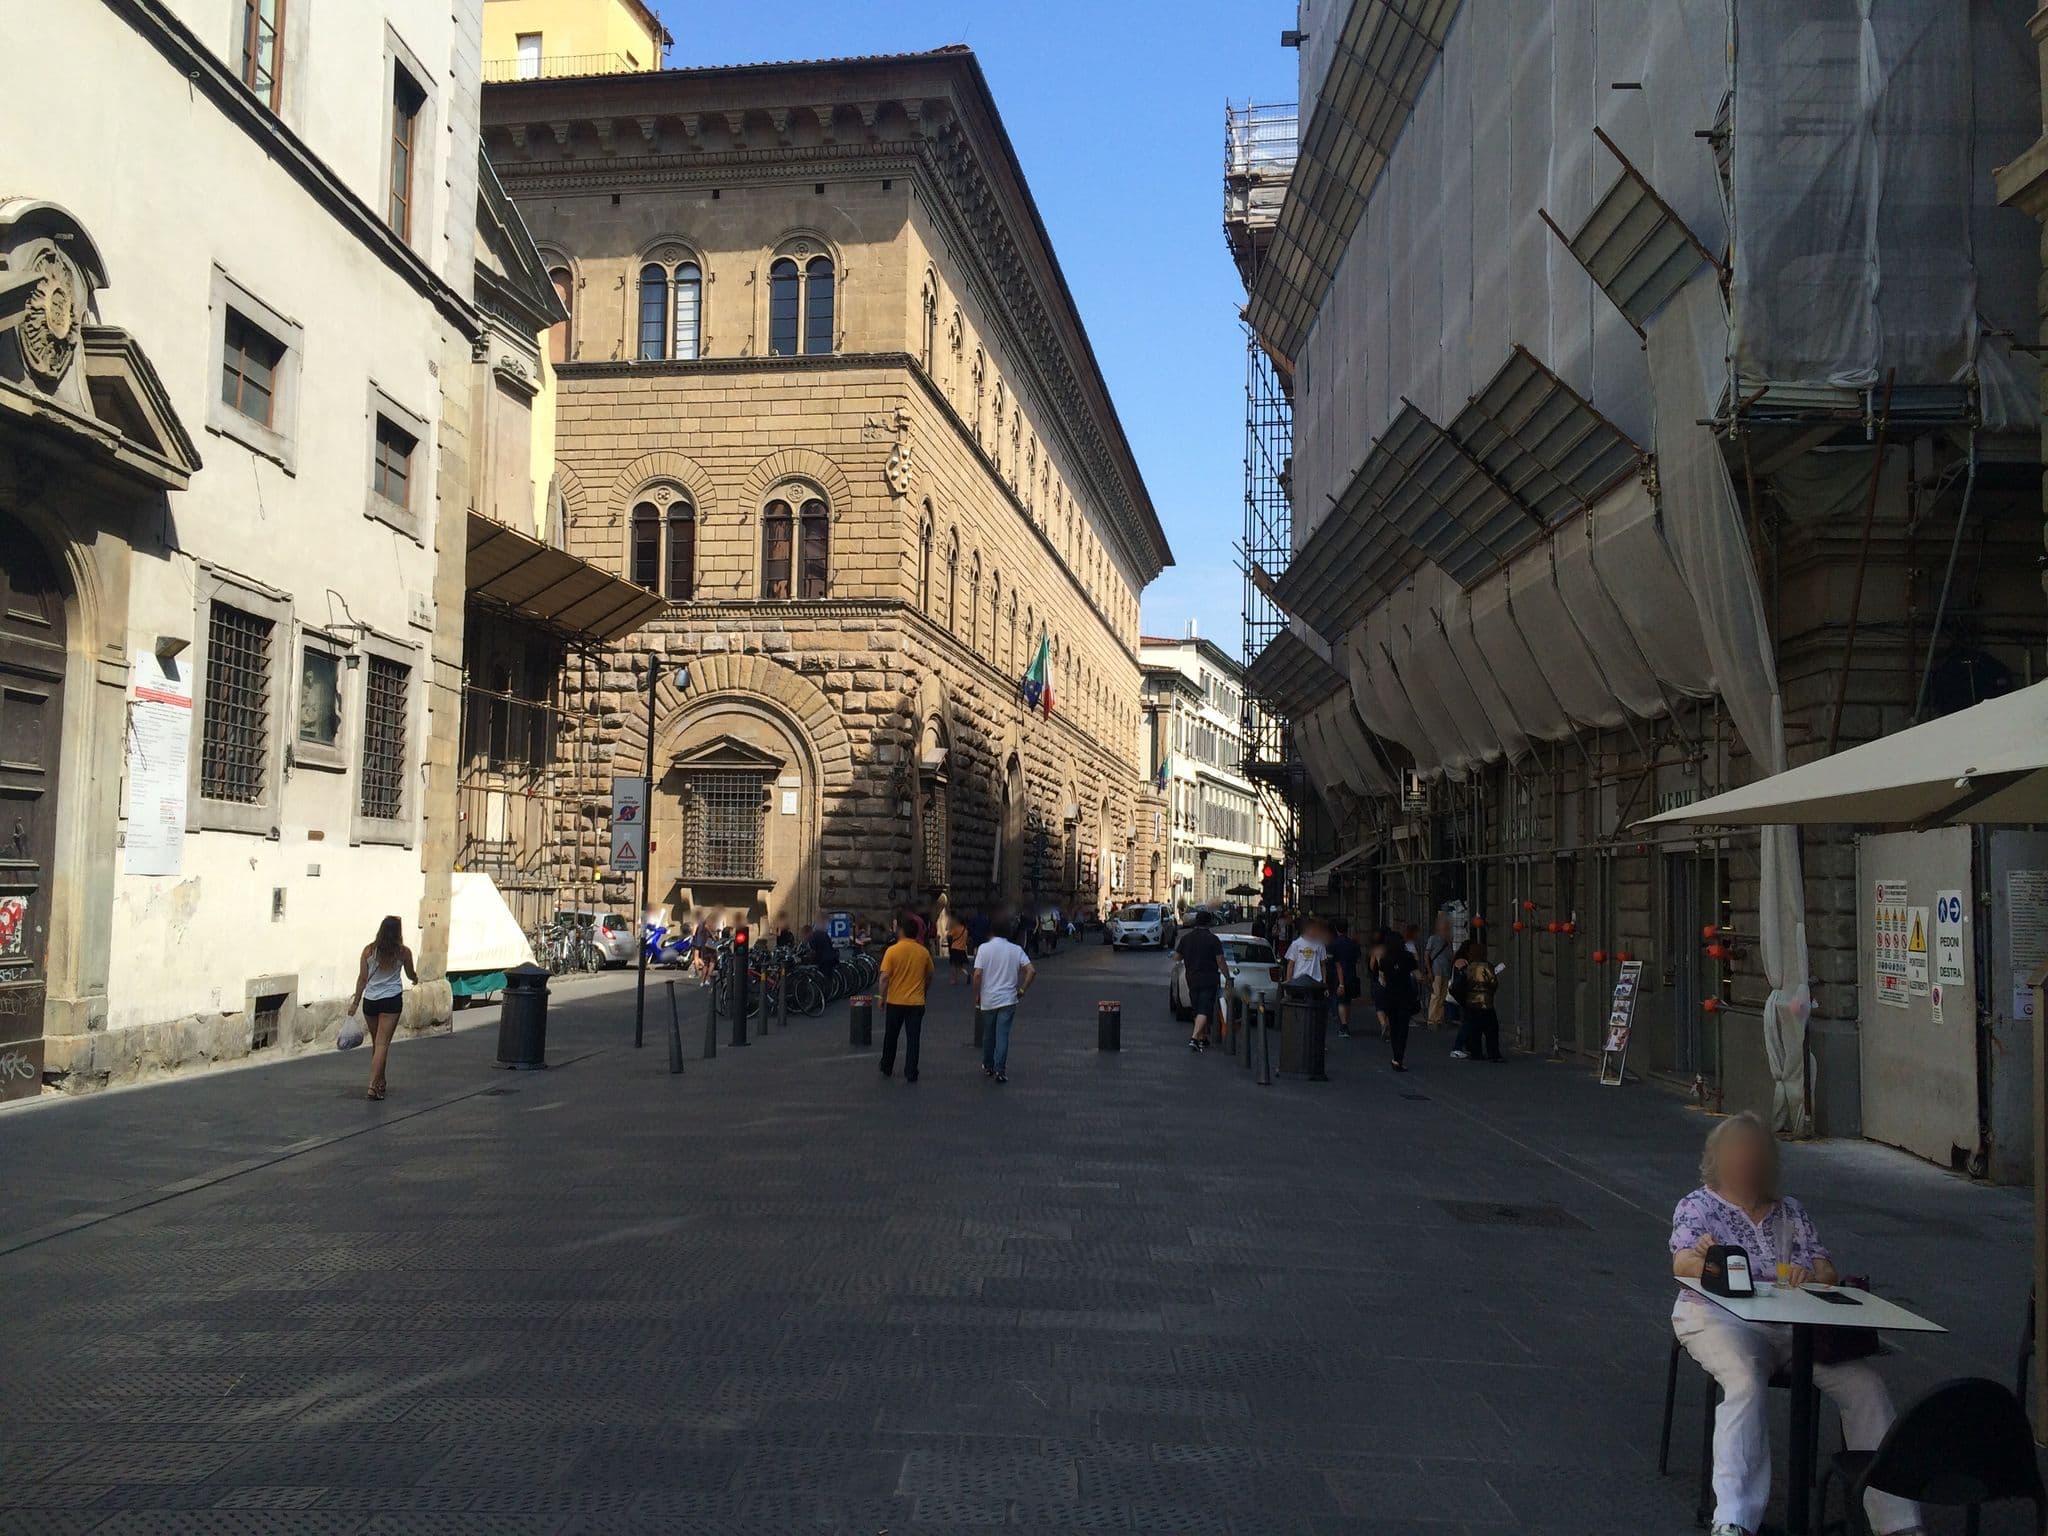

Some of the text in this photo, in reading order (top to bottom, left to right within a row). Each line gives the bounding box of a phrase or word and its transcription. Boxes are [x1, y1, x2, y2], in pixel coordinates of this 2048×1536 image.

[834, 921, 847, 937] P
[1939, 936, 1960, 948] PEDONI
[1947, 952, 1953, 963] A
[1939, 966, 1962, 978] DESTRA
